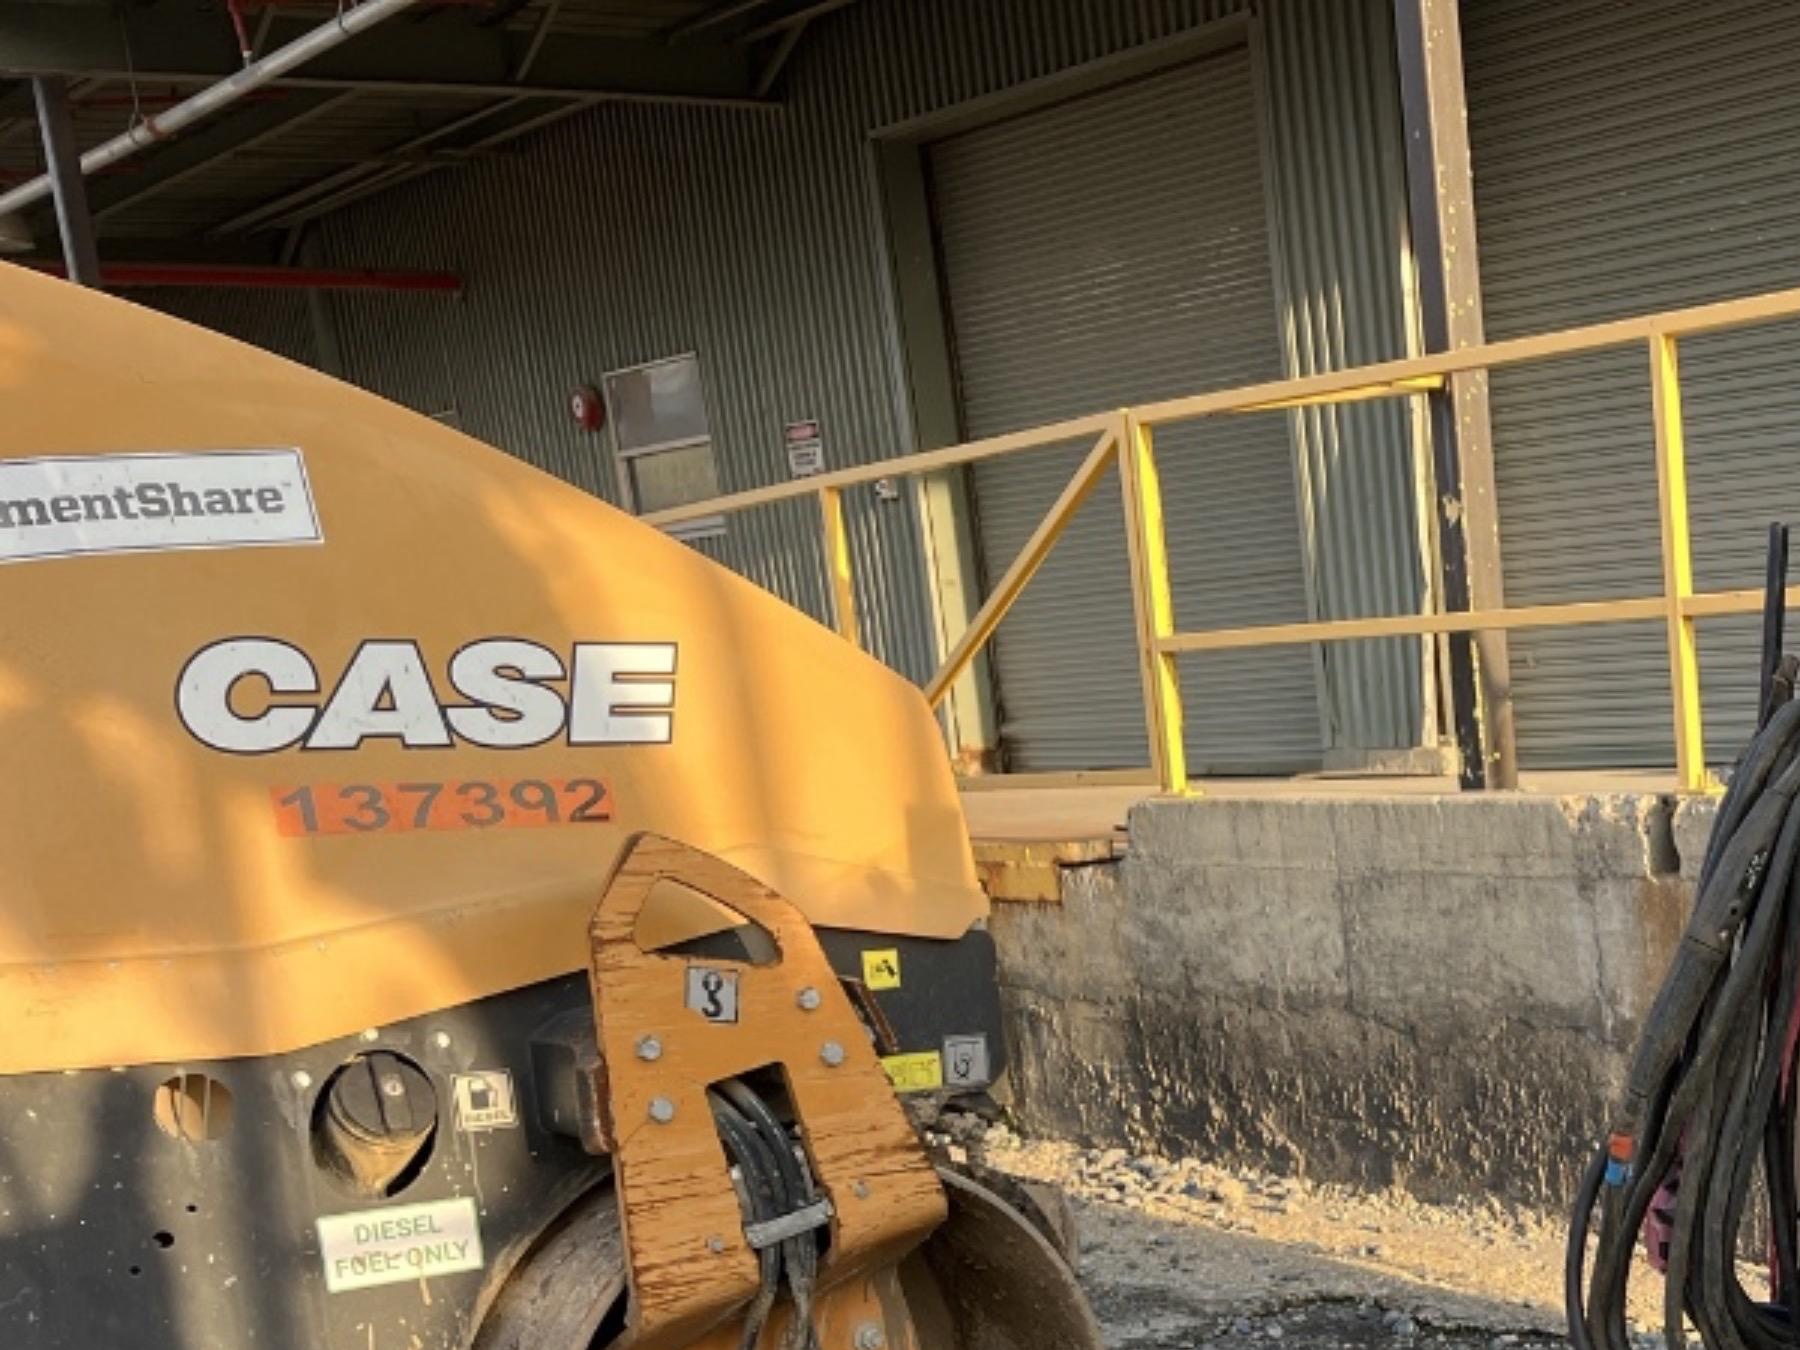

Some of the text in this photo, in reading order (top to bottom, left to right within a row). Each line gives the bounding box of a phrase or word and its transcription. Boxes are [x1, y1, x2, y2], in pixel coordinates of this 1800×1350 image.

[174, 635, 679, 756] CASE
[279, 778, 611, 833] 137392
[353, 1214, 443, 1244] DIESEL
[406, 1239, 469, 1268] ONLY
